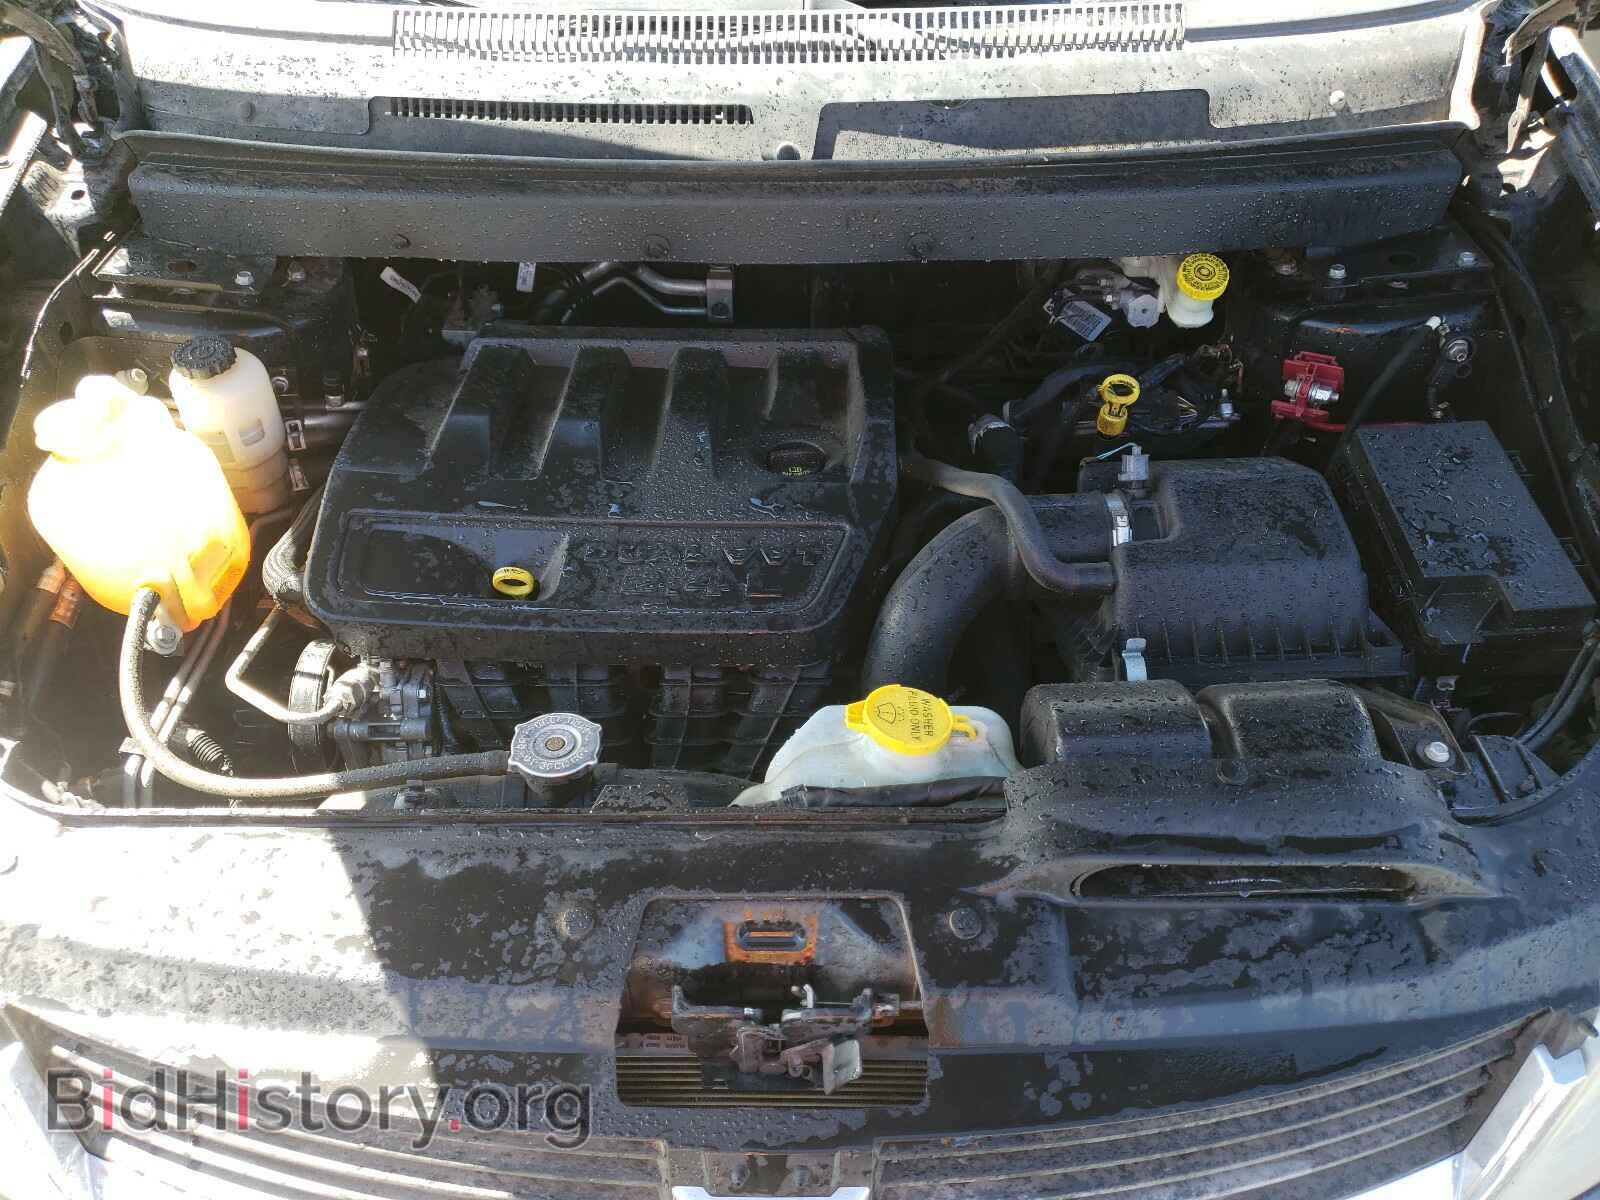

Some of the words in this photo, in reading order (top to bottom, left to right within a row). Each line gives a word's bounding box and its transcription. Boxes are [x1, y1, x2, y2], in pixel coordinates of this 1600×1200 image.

[907, 690, 919, 717] FLUID
[910, 718, 921, 741] ONLY
[920, 698, 934, 737] WASHER
